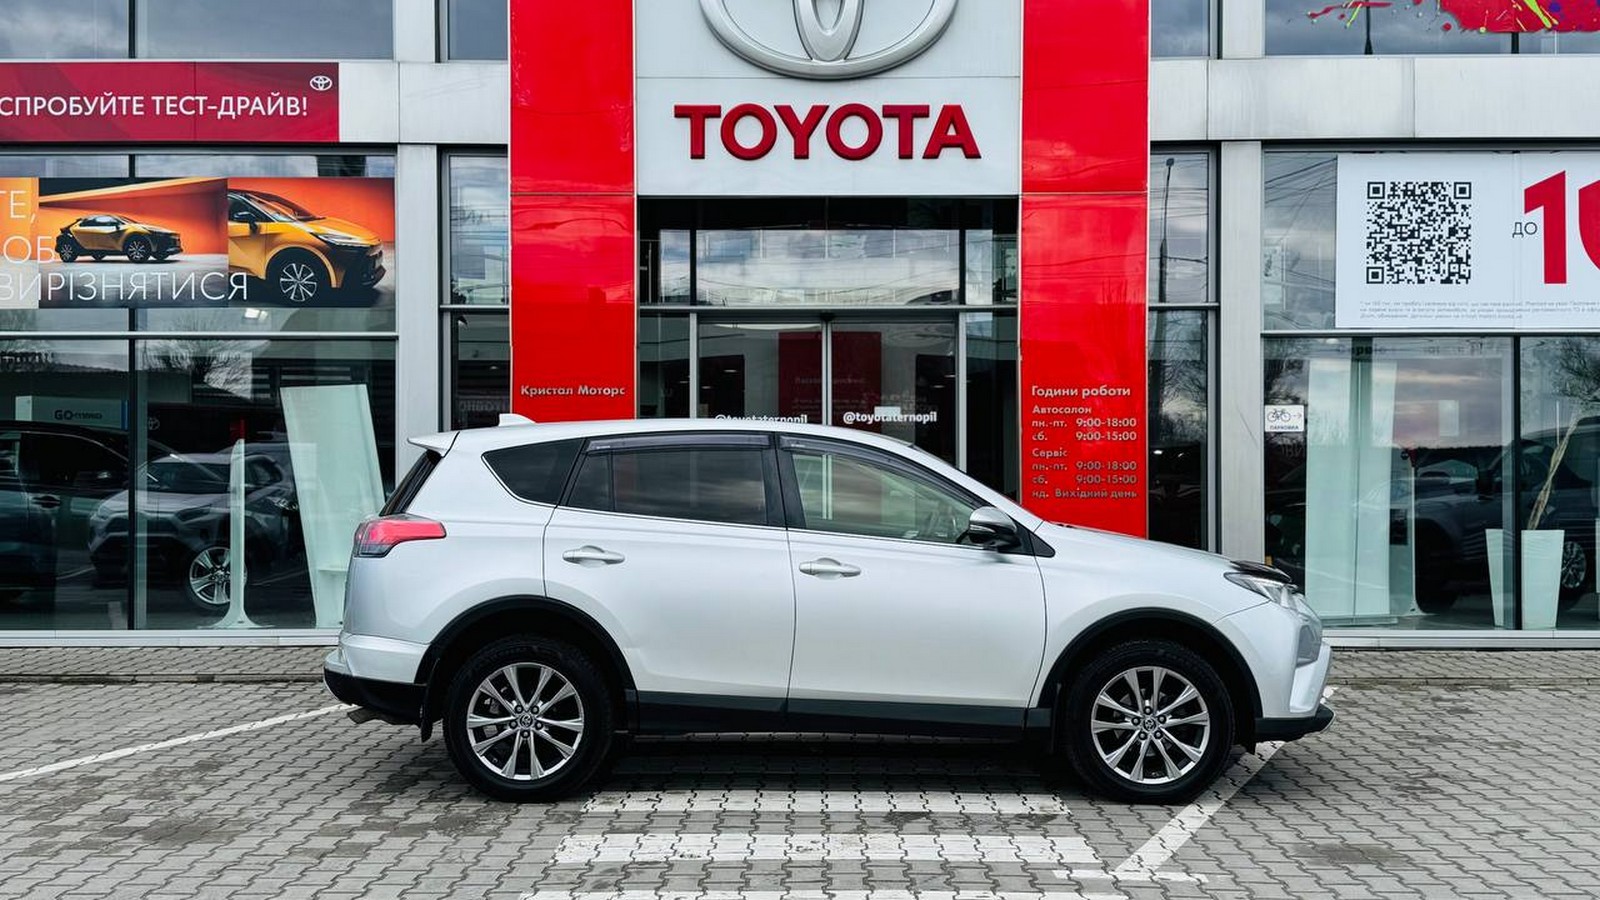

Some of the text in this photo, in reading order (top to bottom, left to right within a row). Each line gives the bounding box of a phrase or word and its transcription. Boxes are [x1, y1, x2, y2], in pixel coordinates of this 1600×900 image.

[0, 92, 307, 119] СПРОБУЙТЕ ТЕСТ-ДРАЙВ!
[673, 103, 982, 161] TOYOTA
[0, 271, 247, 301] ВИРІЗНЯТИСЯ
[520, 385, 626, 398] Кристал Моторс
[1031, 384, 1131, 399] Години роботи
[1032, 405, 1092, 414] Автосалон
[843, 411, 937, 424] @toyotaternopil
[1076, 418, 1137, 428] 9:00-18:00
[1032, 431, 1137, 441] сб. 9:00-15:00
[1032, 447, 1067, 459] Сервіс
[1076, 461, 1137, 470] 9:00-18:00
[1032, 474, 1137, 484] сб. 9:00-15:00
[1032, 487, 1138, 499] нд. Вихідний день
